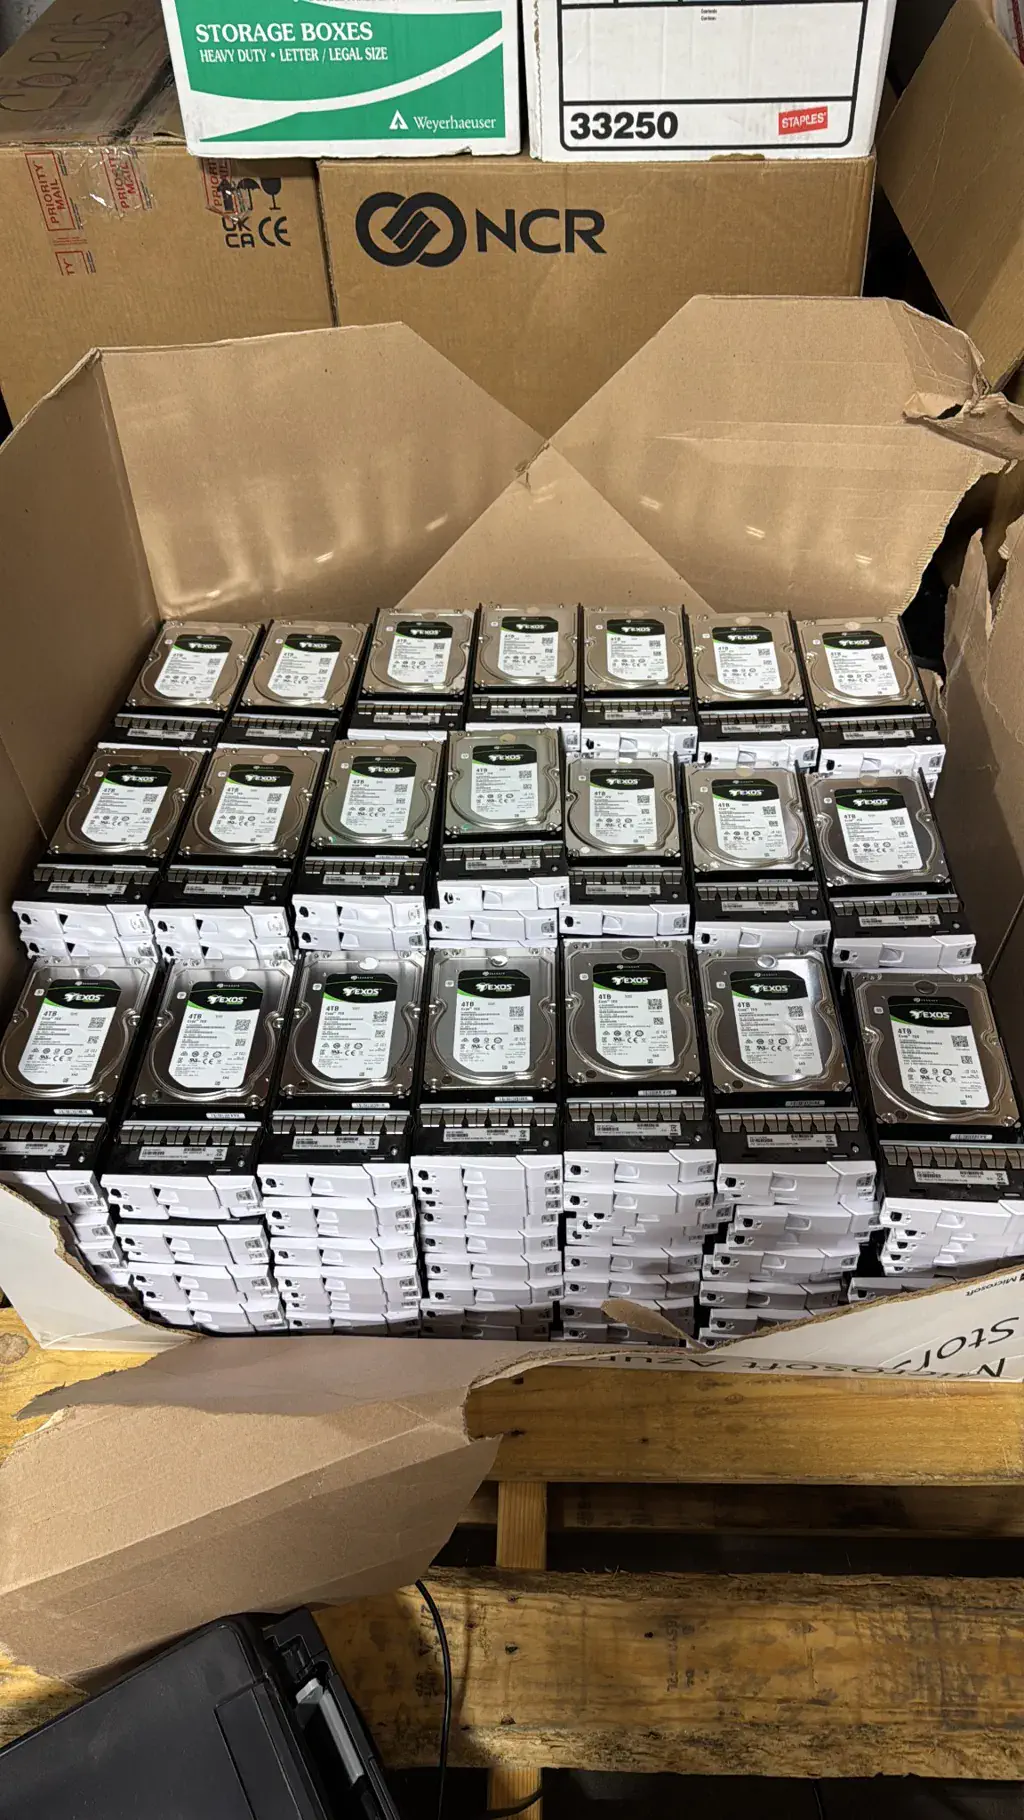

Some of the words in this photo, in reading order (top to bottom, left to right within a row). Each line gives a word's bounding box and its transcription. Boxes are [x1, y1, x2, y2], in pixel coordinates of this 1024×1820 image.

[195, 23, 296, 43] STORAGE
[301, 21, 374, 42] BOXES
[200, 49, 235, 63] HEAVY
[238, 48, 267, 62] DUTY
[279, 48, 320, 62] LETTER
[329, 47, 363, 62] LEGAL
[365, 46, 389, 61] SIZE
[413, 115, 497, 133] Weyerhaeuser
[570, 111, 679, 140] 33250
[781, 112, 826, 129] STAPLES
[34, 162, 59, 225] PRIORITY
[50, 179, 66, 210] MAIL
[207, 158, 223, 207] PRIORI
[258, 216, 291, 247] CE
[476, 208, 607, 254] NCR
[965, 1276, 1017, 1296] Microsoft
